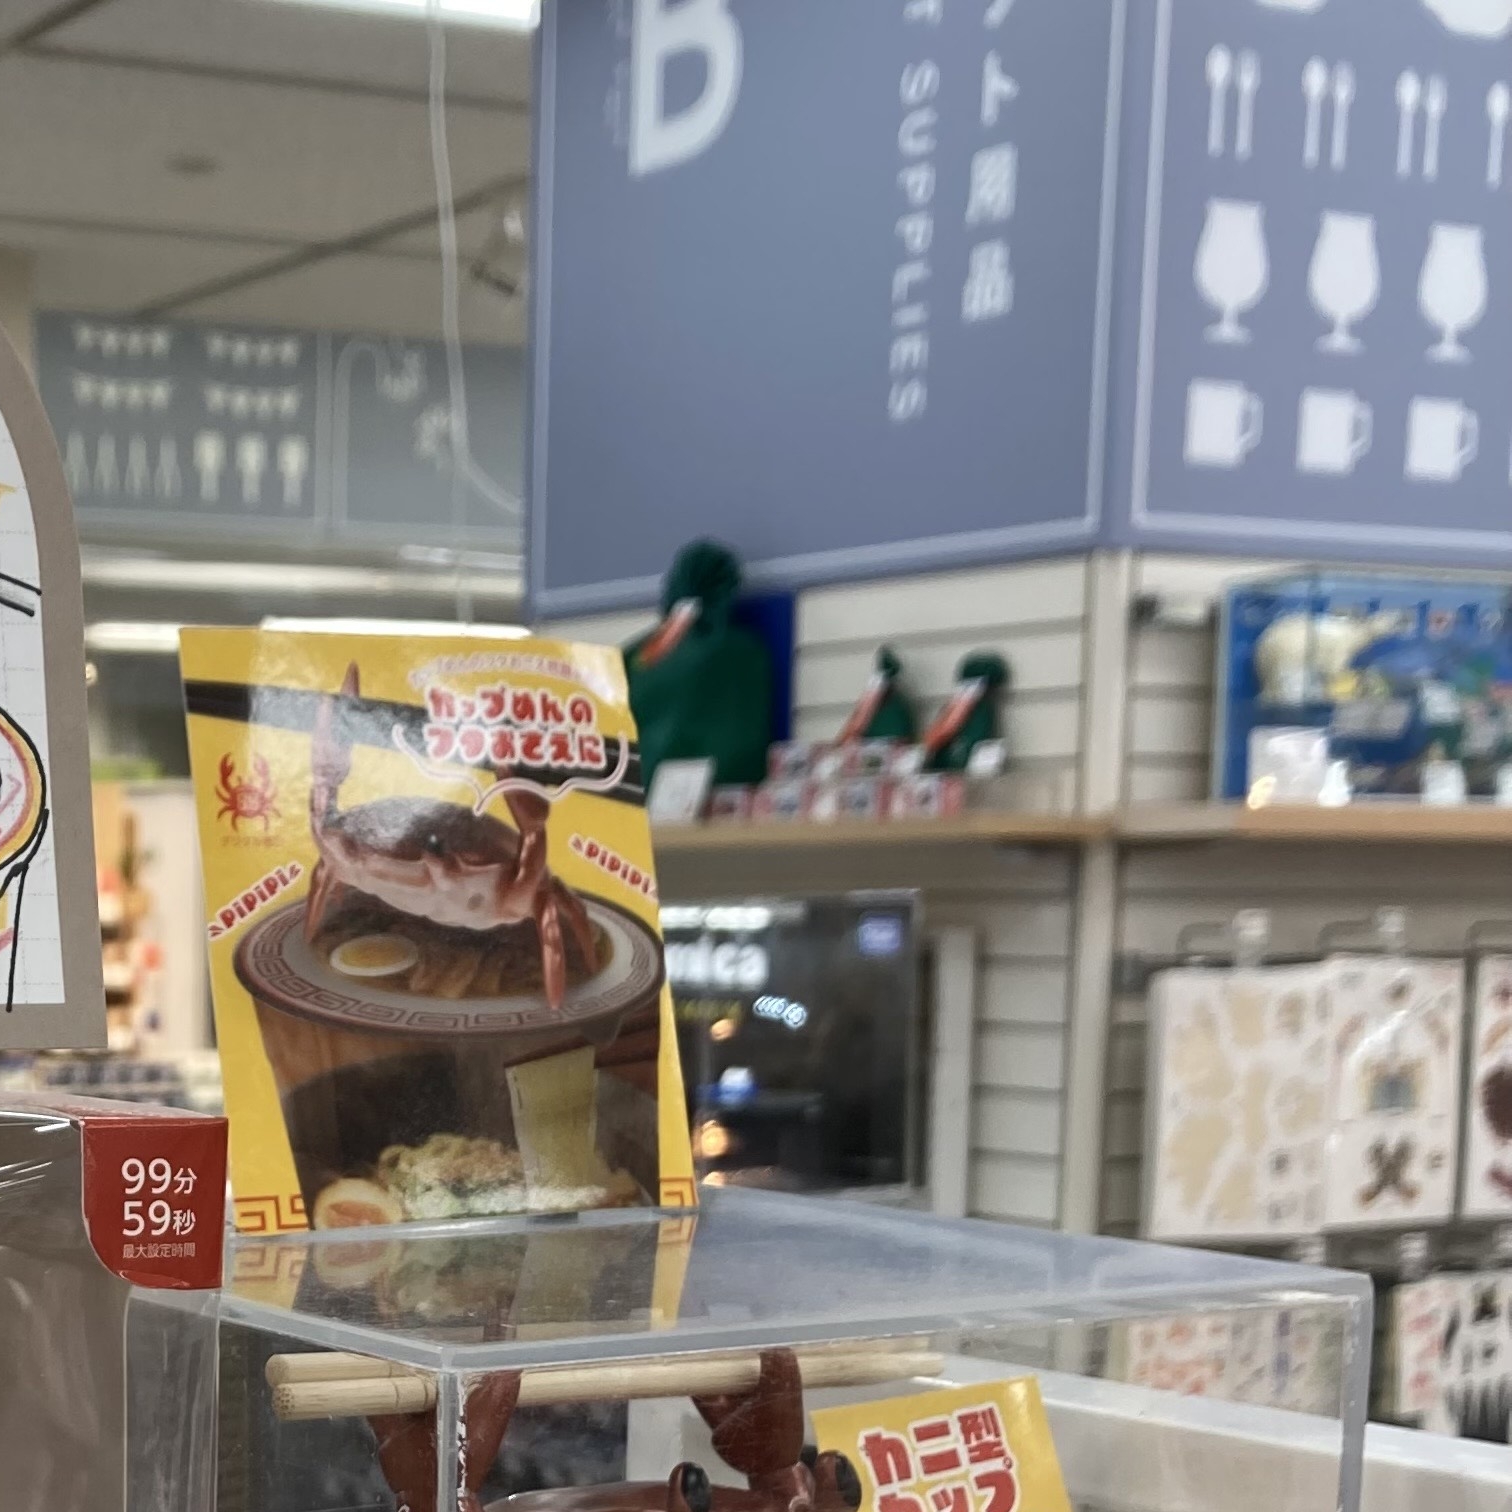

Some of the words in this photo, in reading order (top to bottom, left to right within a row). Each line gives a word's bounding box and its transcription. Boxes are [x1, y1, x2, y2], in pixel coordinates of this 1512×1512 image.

[889, 58, 941, 422] SUPPLIES
[121, 1157, 198, 1195] 99分
[122, 1199, 197, 1237] 59秒
[122, 1242, 196, 1259] 最大設定時間
[862, 1406, 1004, 1487] カニ型
